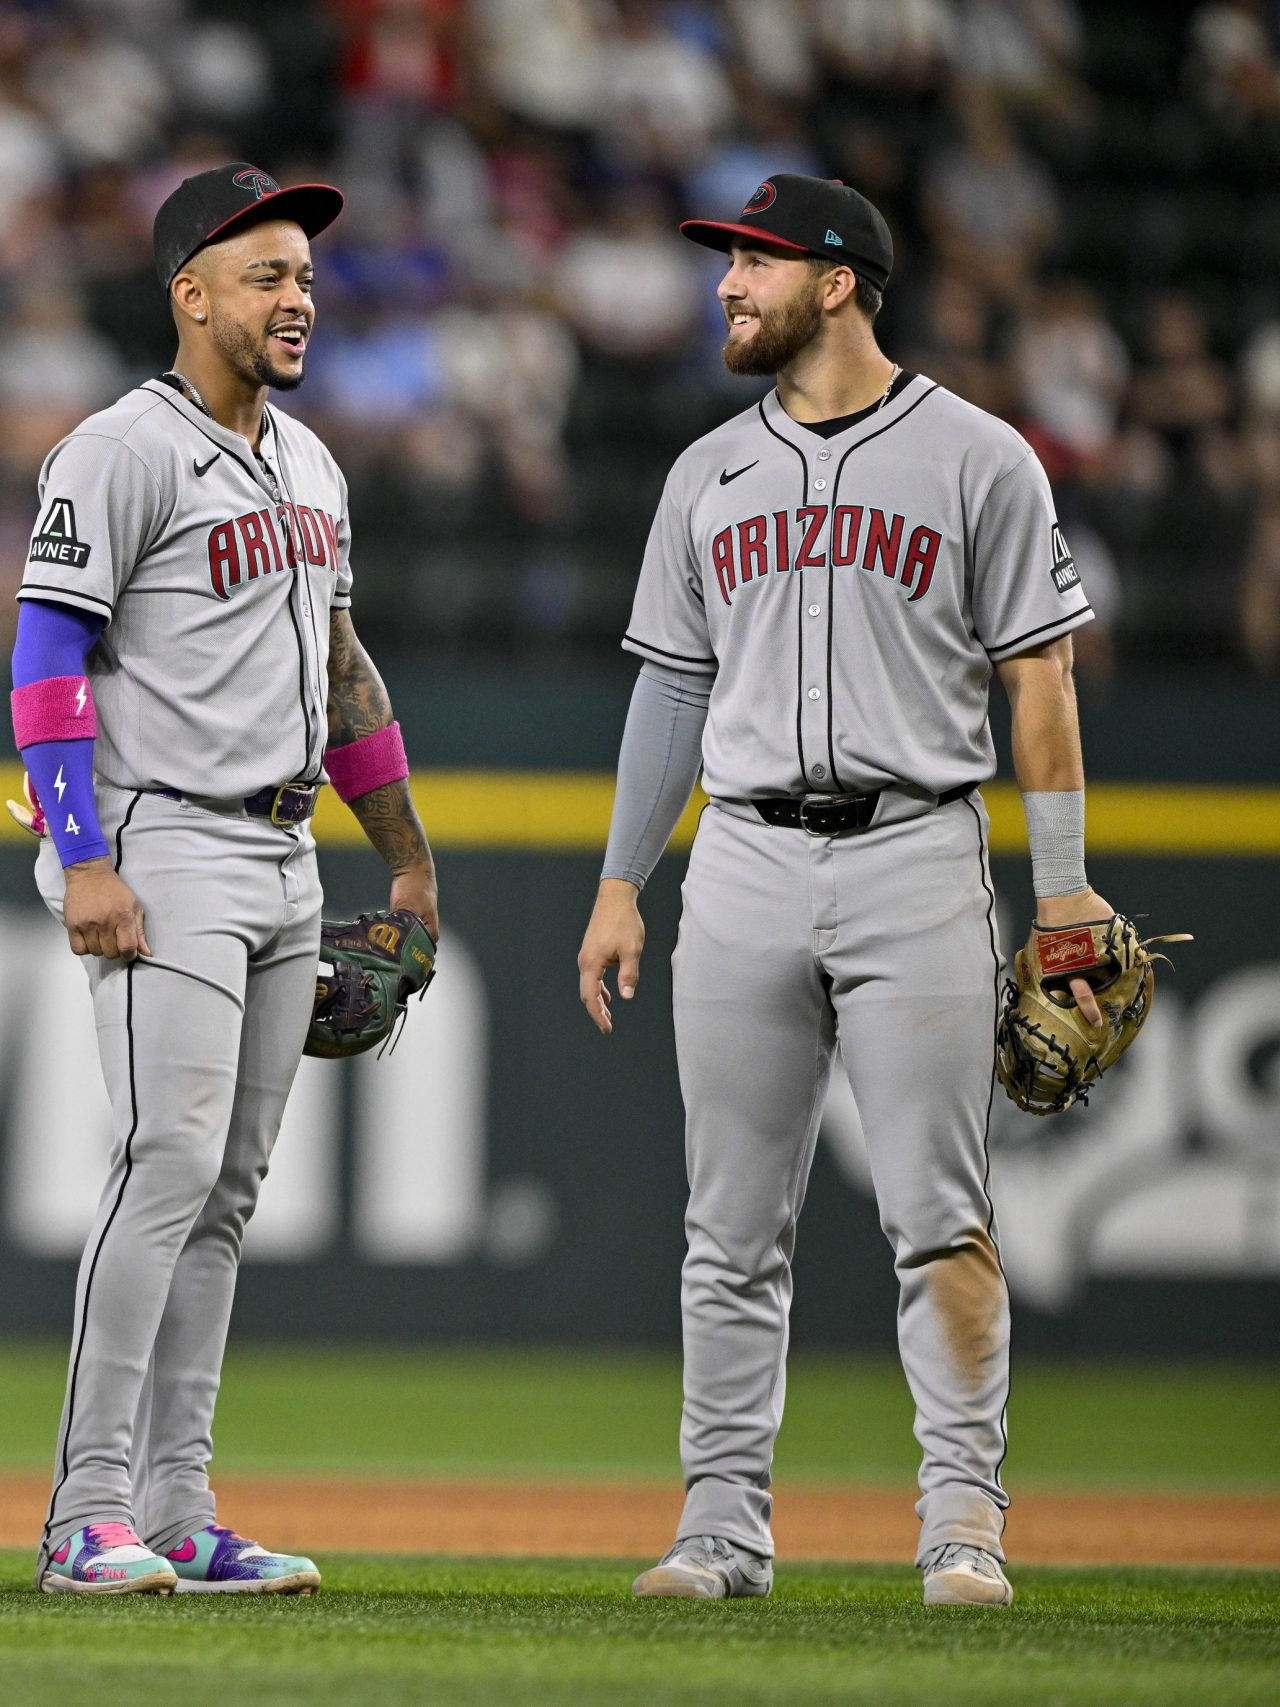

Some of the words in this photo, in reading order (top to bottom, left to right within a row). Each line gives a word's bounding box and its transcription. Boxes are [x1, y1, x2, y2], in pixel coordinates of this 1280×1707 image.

[30, 541, 86, 563] AVNET
[207, 500, 340, 602] ARIZON
[711, 503, 944, 608] ARIZONA
[65, 813, 81, 836] 4
[1045, 941, 1088, 962] Rawlings
